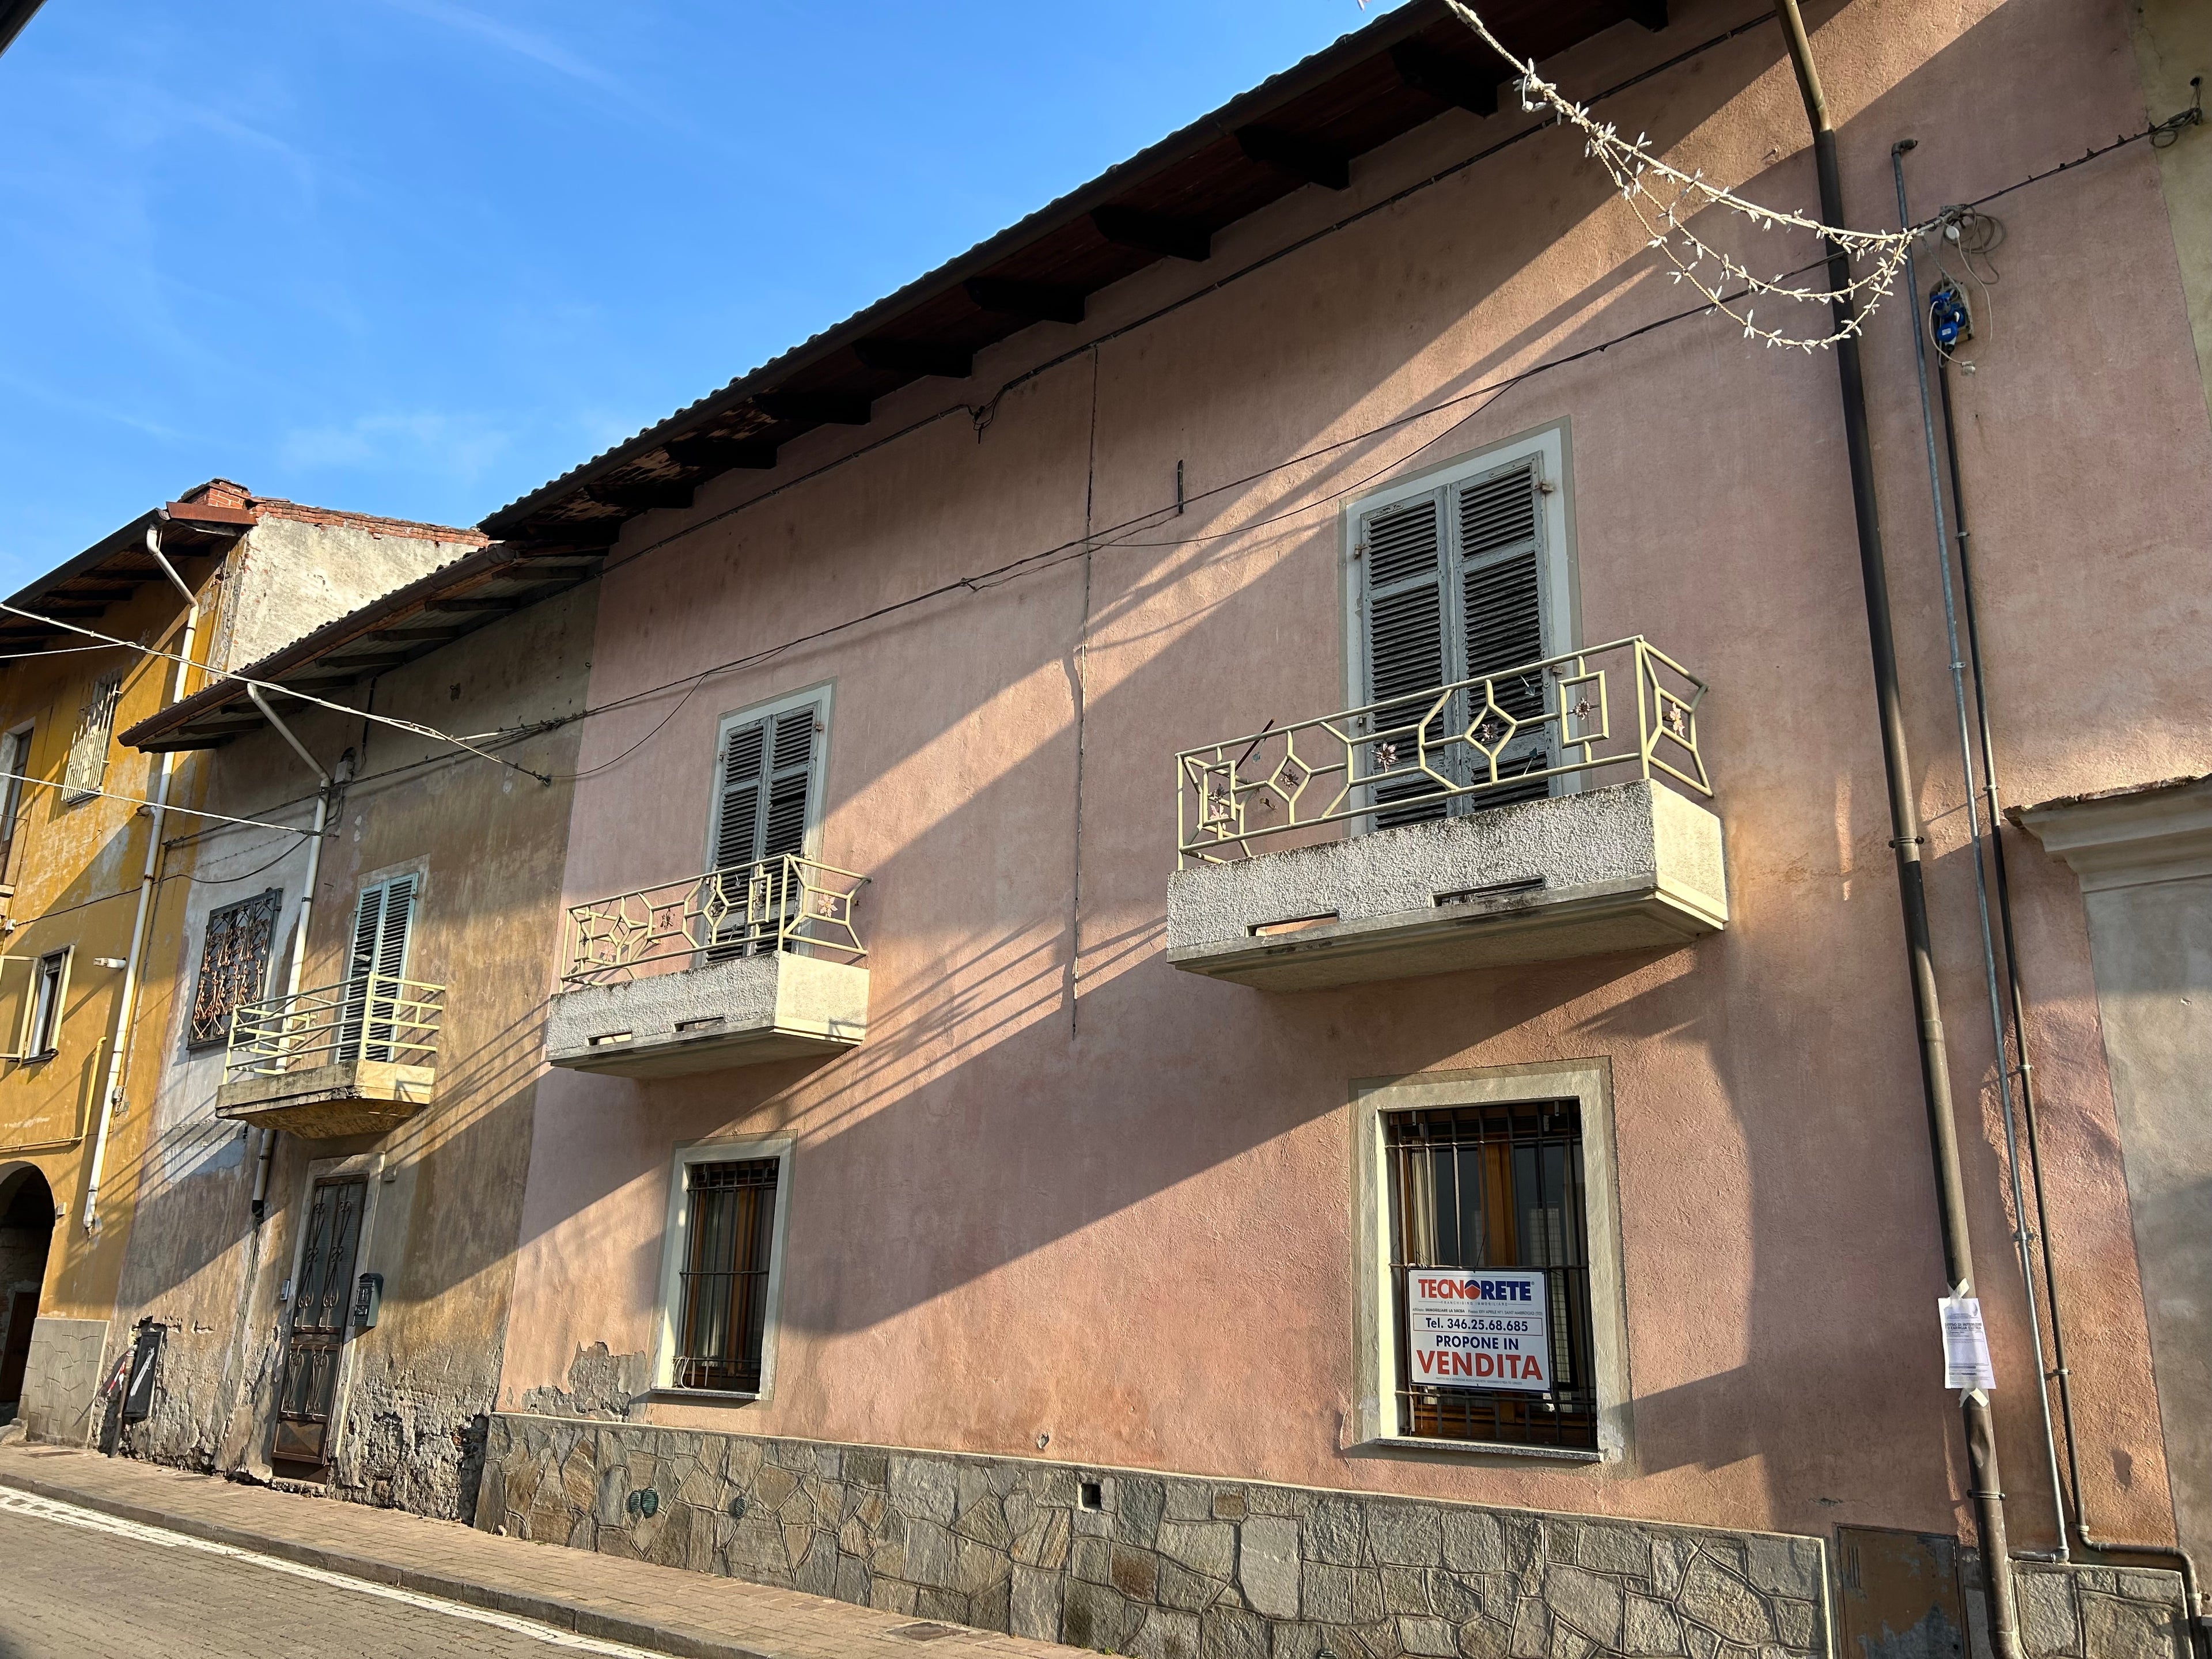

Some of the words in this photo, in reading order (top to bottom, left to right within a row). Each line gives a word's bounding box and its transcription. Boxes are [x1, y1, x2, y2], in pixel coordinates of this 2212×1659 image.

[1418, 1279, 1532, 1301] TECNORETE
[1426, 1317, 1444, 1328] Tel.
[1447, 1318, 1528, 1332] 346.25.68.685
[1436, 1335, 1499, 1350] PROPONE
[1503, 1338, 1519, 1350] IN
[1416, 1350, 1544, 1380] VENDITA
